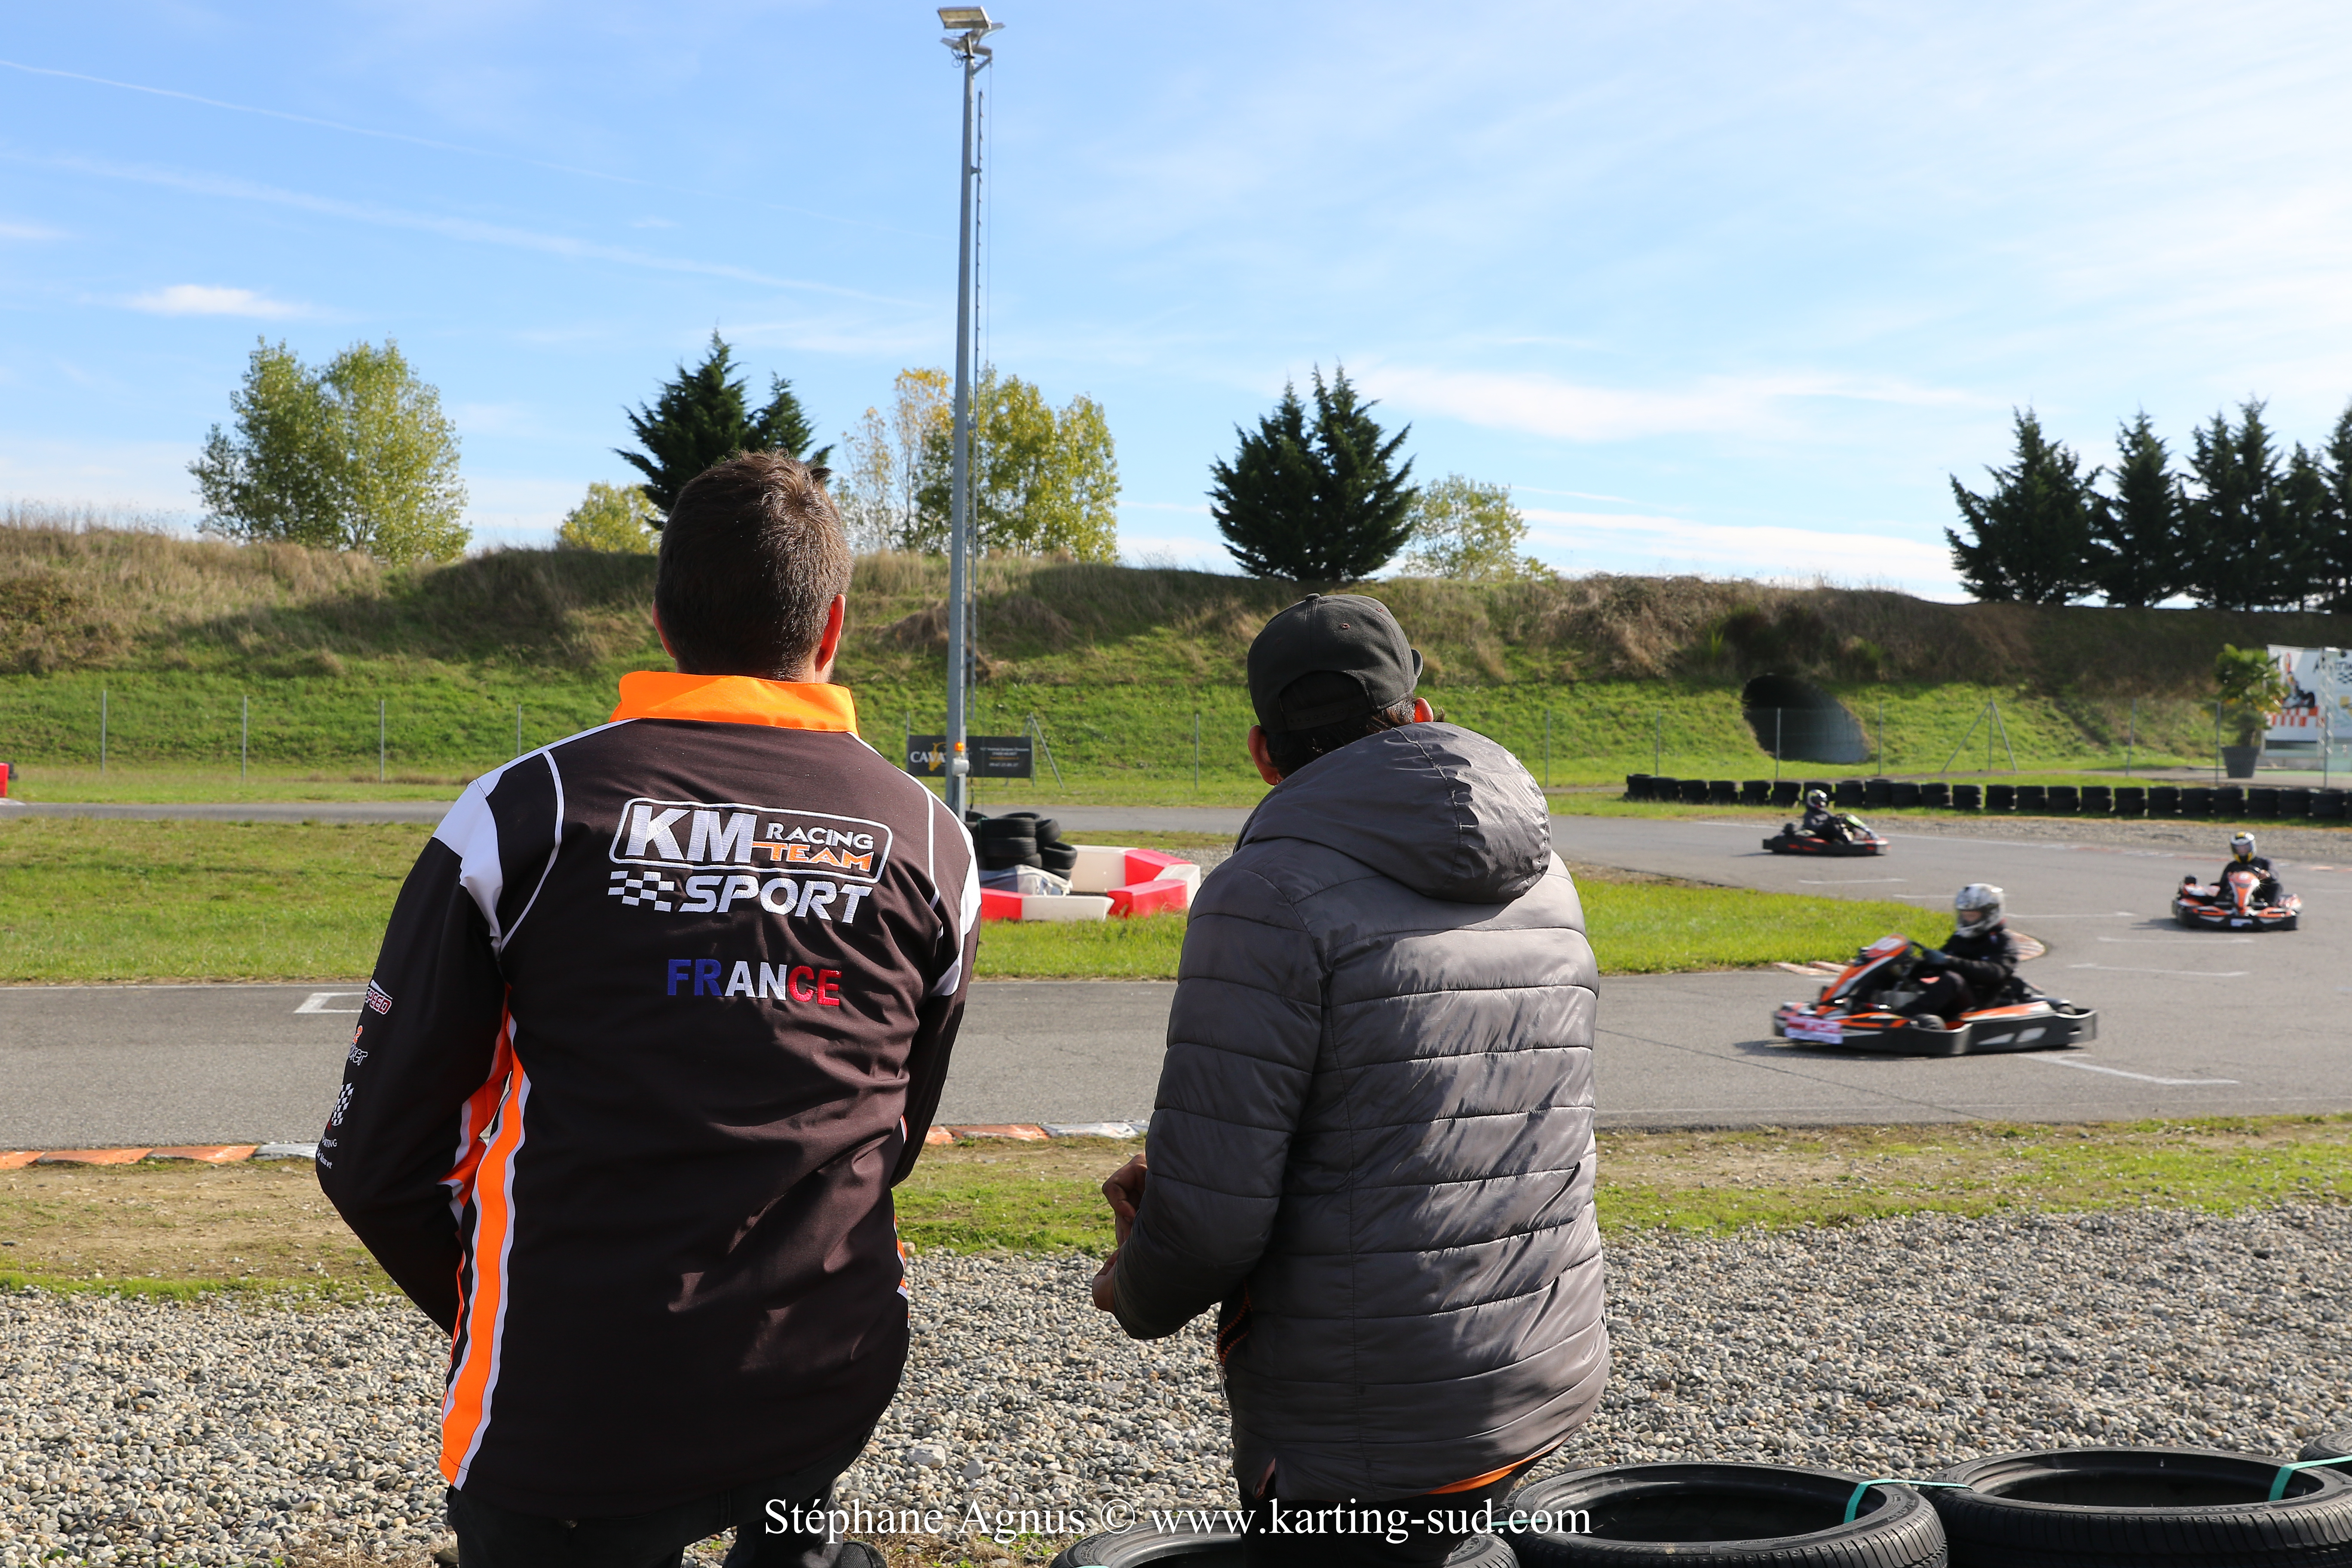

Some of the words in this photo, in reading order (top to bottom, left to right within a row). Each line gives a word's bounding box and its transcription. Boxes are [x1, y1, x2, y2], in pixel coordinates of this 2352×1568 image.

[910, 751, 946, 763] CAVA
[625, 805, 758, 864] KM
[765, 823, 874, 850] RACING
[752, 841, 874, 872] TEAM
[678, 875, 873, 924] SPORT
[667, 959, 842, 1007] FRANCE
